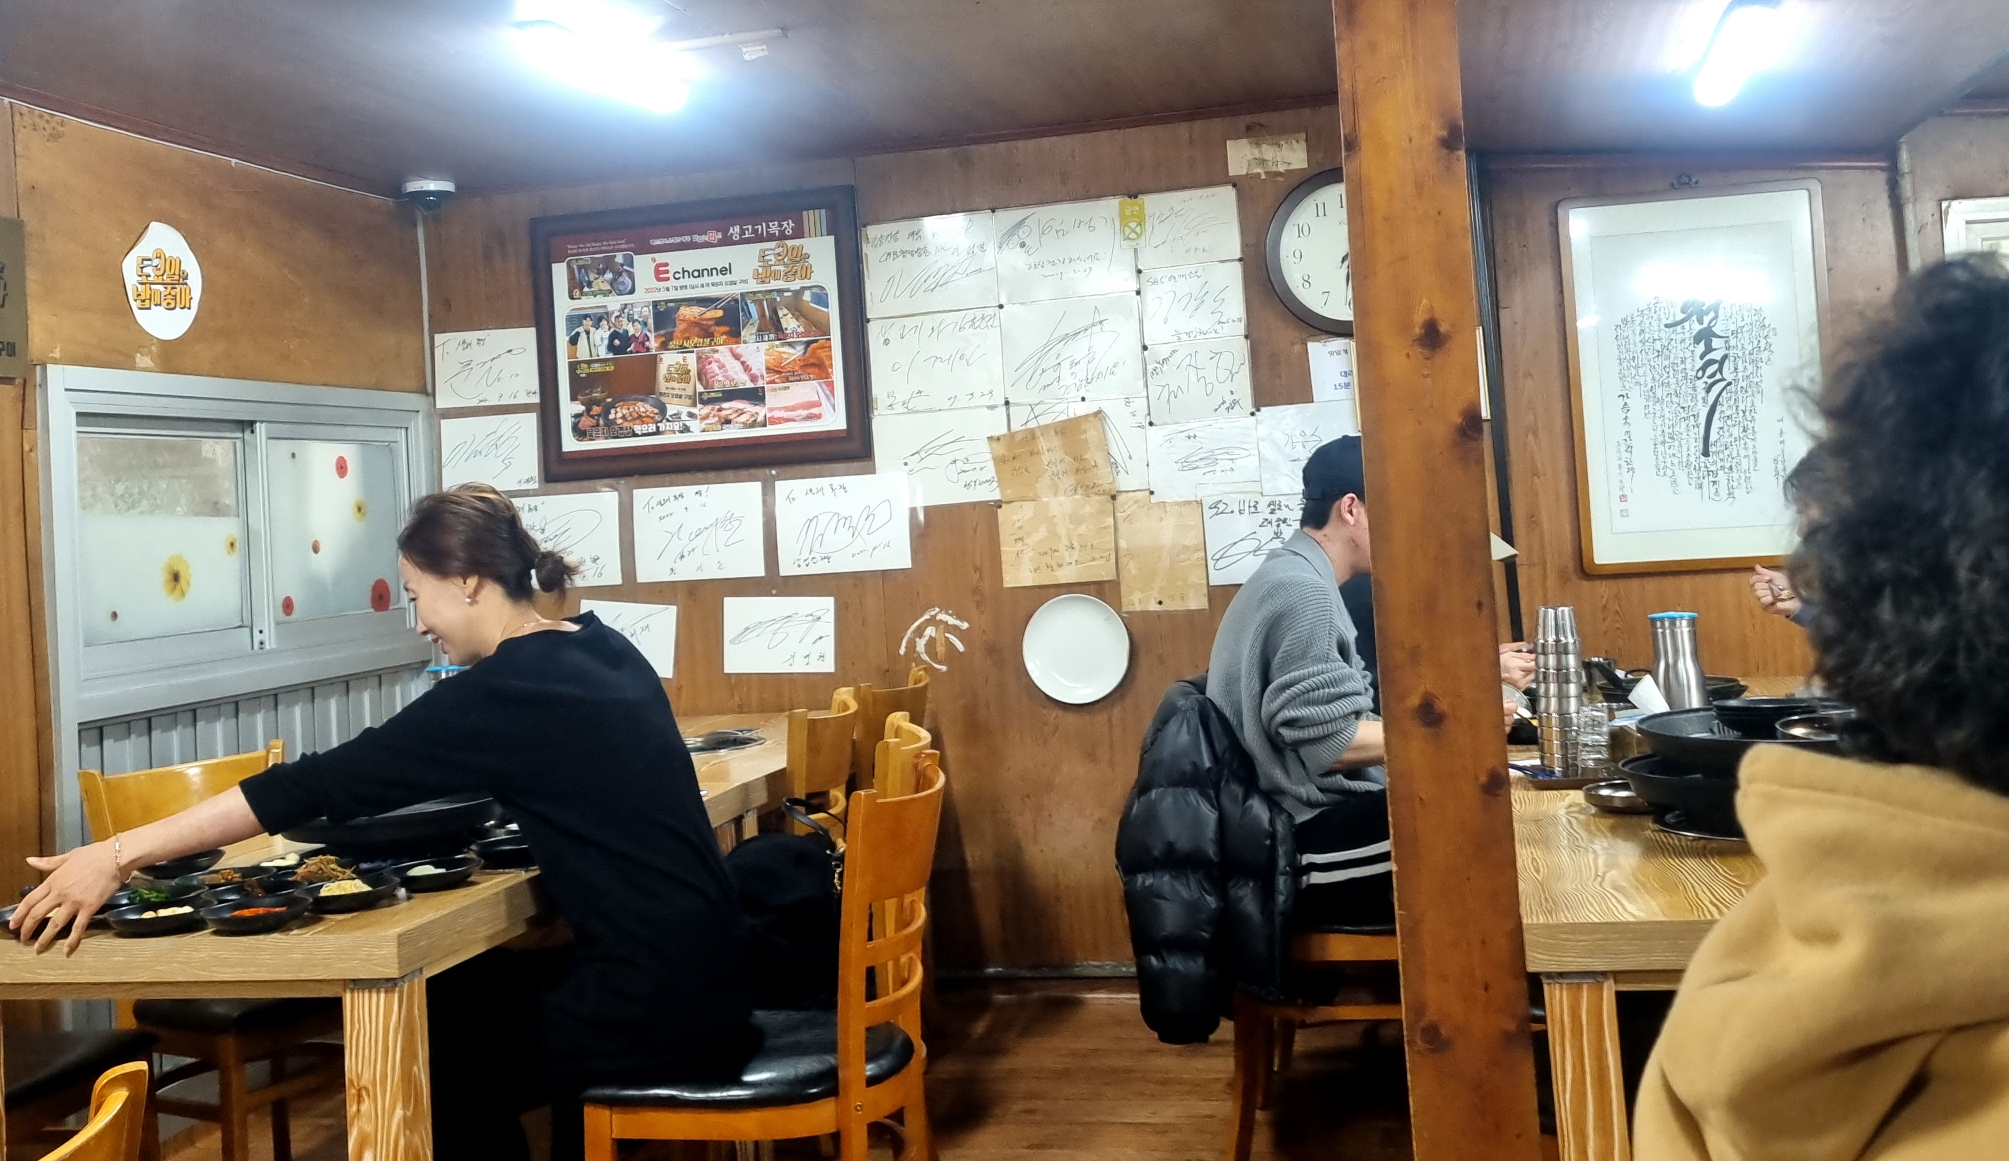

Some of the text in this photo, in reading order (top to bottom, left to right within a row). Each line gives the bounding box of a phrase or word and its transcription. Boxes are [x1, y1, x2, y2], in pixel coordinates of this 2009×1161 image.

[1315, 201, 1327, 217] 11
[727, 219, 796, 241] 생고기목장
[1293, 222, 1311, 238] 10
[1292, 248, 1303, 265] 9
[136, 248, 189, 285] 토요일은
[653, 261, 732, 283] E channel
[1301, 274, 1312, 289] 8
[132, 283, 193, 310] 밥이 좋아
[1322, 291, 1330, 306] 7
[633, 422, 656, 435] 먹으러
[657, 421, 683, 432] 가지요!
